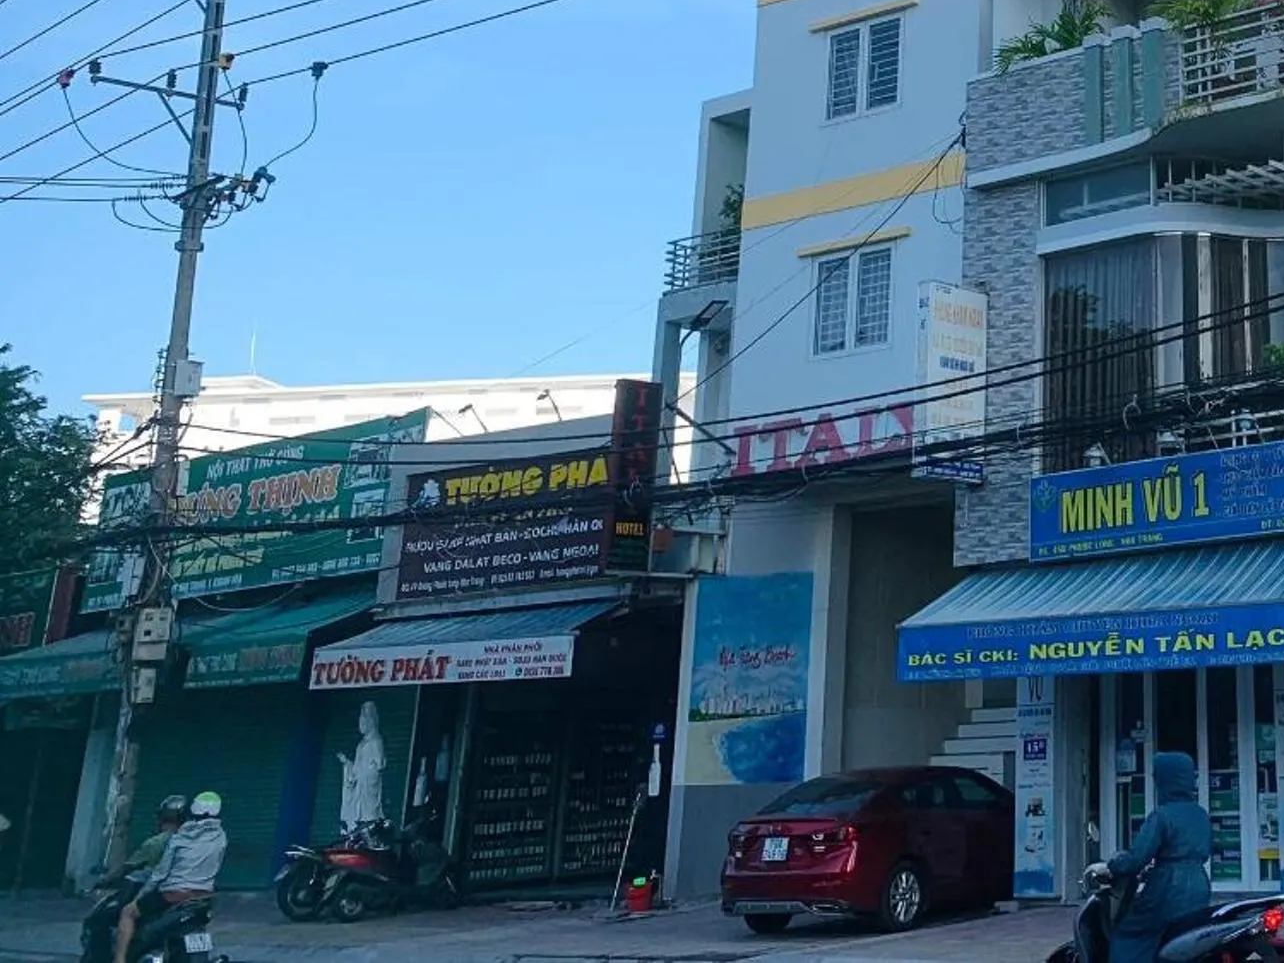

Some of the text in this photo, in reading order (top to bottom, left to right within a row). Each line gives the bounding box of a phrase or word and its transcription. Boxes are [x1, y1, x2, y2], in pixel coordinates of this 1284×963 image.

[549, 454, 609, 491] PHÁ
[1061, 481, 1135, 534] MINH
[1141, 464, 1184, 523] VŨ
[1190, 471, 1211, 518] 1
[615, 521, 645, 536] HOTEL
[424, 558, 452, 575] VANG
[454, 555, 490, 570] DALAT
[529, 547, 560, 563] VANG
[908, 650, 947, 666] BÁC
[1029, 631, 1144, 660] NGUYỄN
[1154, 628, 1215, 653] TẤN
[312, 653, 385, 686] TƯỜNG
[390, 648, 452, 682] PHÁT
